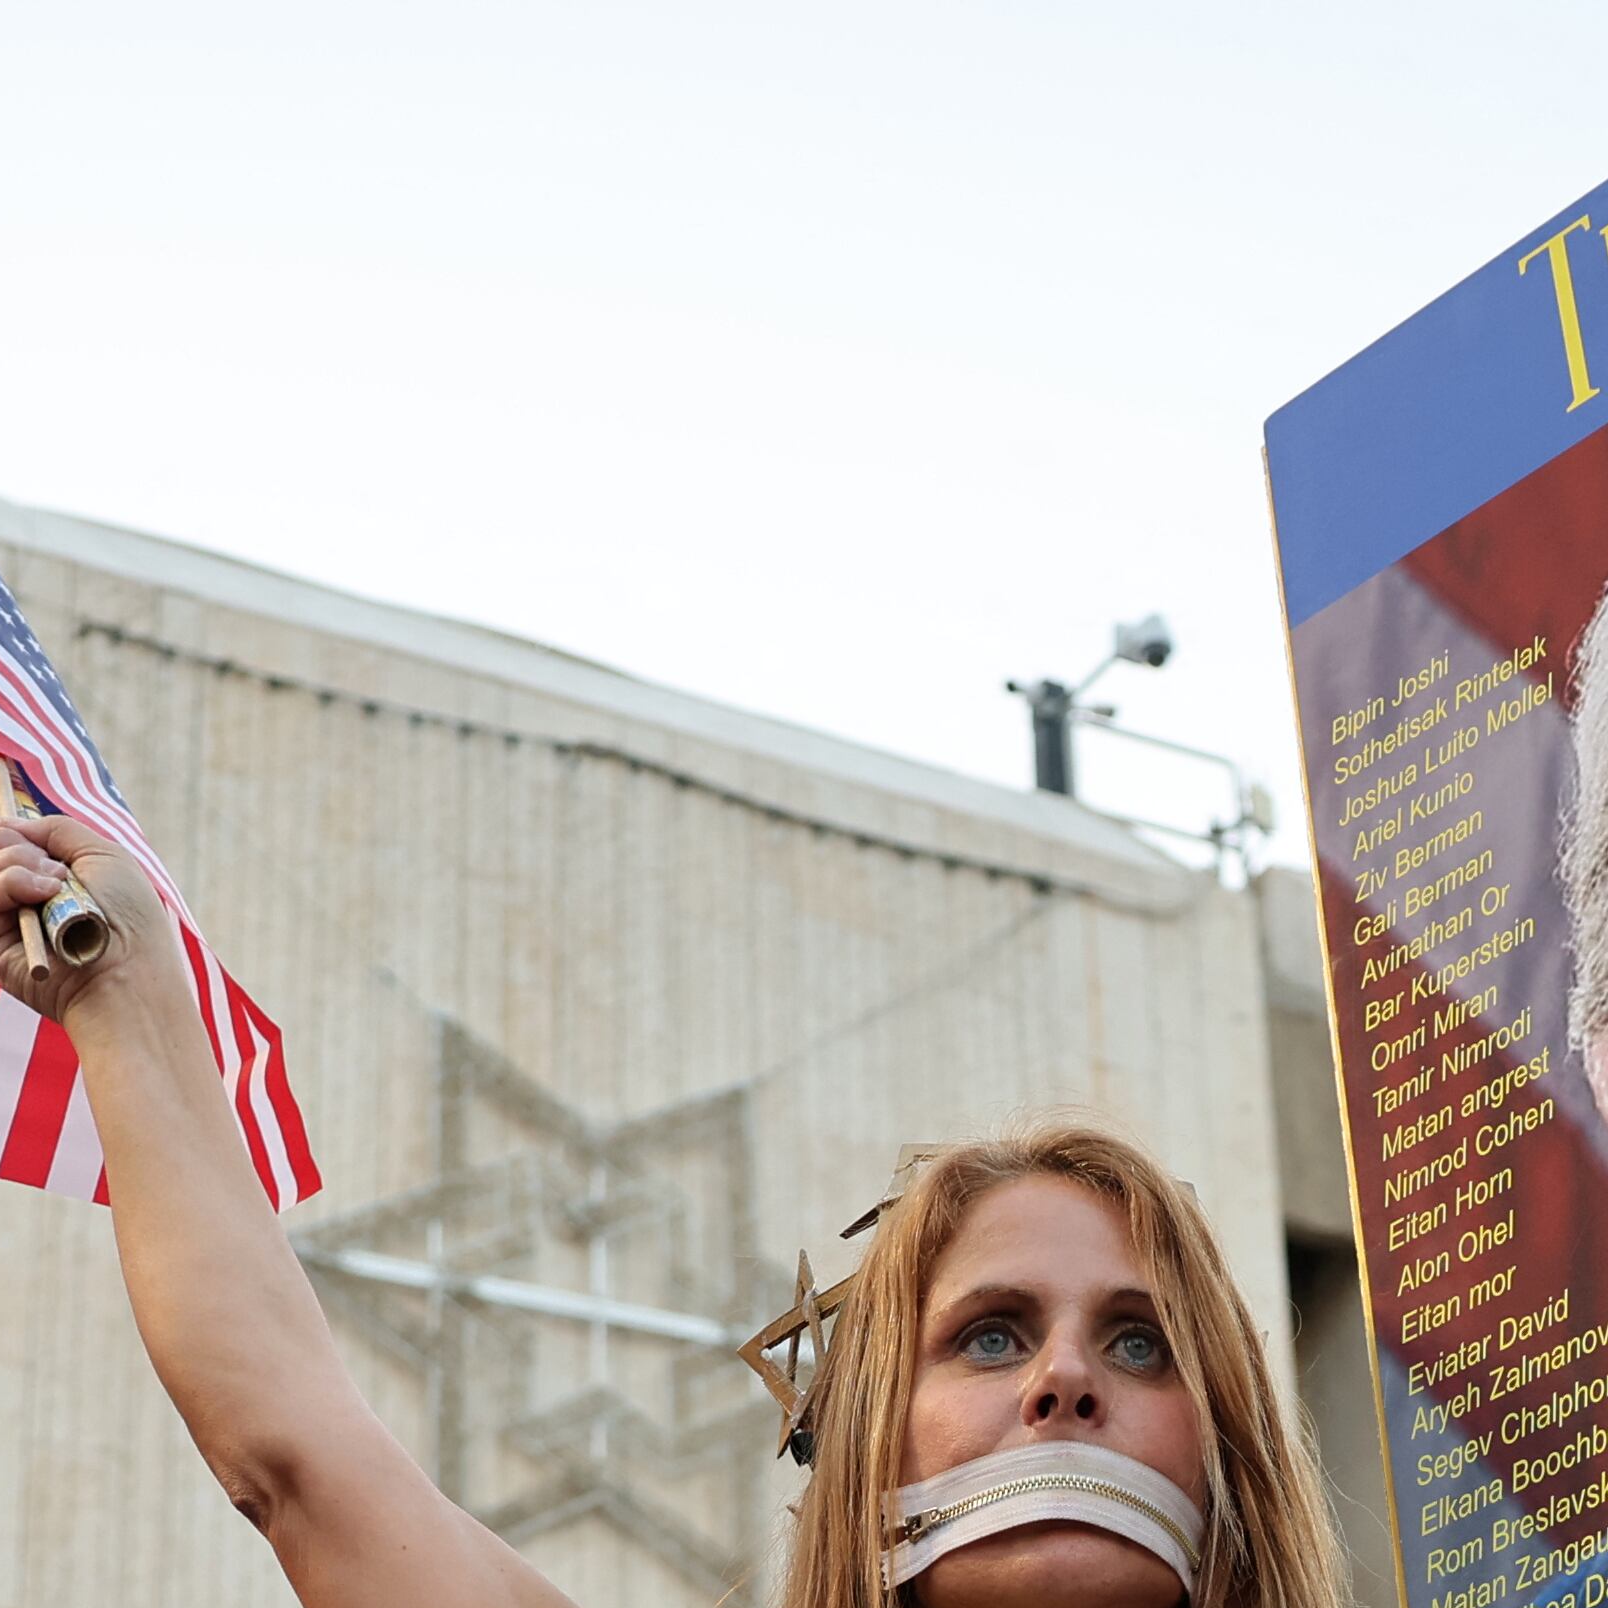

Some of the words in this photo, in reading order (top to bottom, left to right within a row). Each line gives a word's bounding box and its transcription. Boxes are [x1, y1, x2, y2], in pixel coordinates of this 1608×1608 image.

[1331, 697, 1386, 745] Bipin
[1392, 650, 1450, 707] Joshi
[1335, 698, 1448, 784] Sothetisak
[1454, 635, 1548, 710] Rintelak
[1339, 764, 1418, 827] Joshua
[1425, 726, 1480, 773] Luito
[1486, 672, 1553, 735] Mollel
[1352, 811, 1403, 860] Ariel
[1410, 772, 1475, 822] Kunio
[1355, 868, 1387, 902] Ziv
[1395, 810, 1484, 878] Berman
[1352, 898, 1396, 945] Gali
[1404, 849, 1495, 916] Berman
[1362, 908, 1474, 987] Avinathan
[1480, 884, 1511, 917] Or
[1364, 992, 1404, 1032] Bar
[1410, 917, 1537, 1004] Kuperstein
[1369, 1027, 1427, 1072] Omri
[1434, 985, 1500, 1034] Miran
[1373, 1067, 1434, 1116] Tamir
[1441, 1009, 1533, 1079] Nimrodi
[1382, 1104, 1453, 1158] Matan
[1460, 1046, 1551, 1117] angrest
[1384, 1141, 1468, 1205] Nimrod
[1474, 1098, 1556, 1156] Cohen
[1387, 1203, 1448, 1251] Eitan
[1455, 1168, 1515, 1215] Horn
[1397, 1252, 1452, 1295] Alon
[1457, 1210, 1517, 1263] Ohel
[1401, 1296, 1461, 1344] Eitan
[1467, 1264, 1516, 1309] mor
[1408, 1335, 1493, 1396] Eviatar
[1498, 1289, 1571, 1350] David
[1412, 1385, 1481, 1440] Aryeh
[1416, 1435, 1492, 1486] Segev
[1420, 1478, 1505, 1536] Elkana
[1426, 1537, 1485, 1582] Rom
